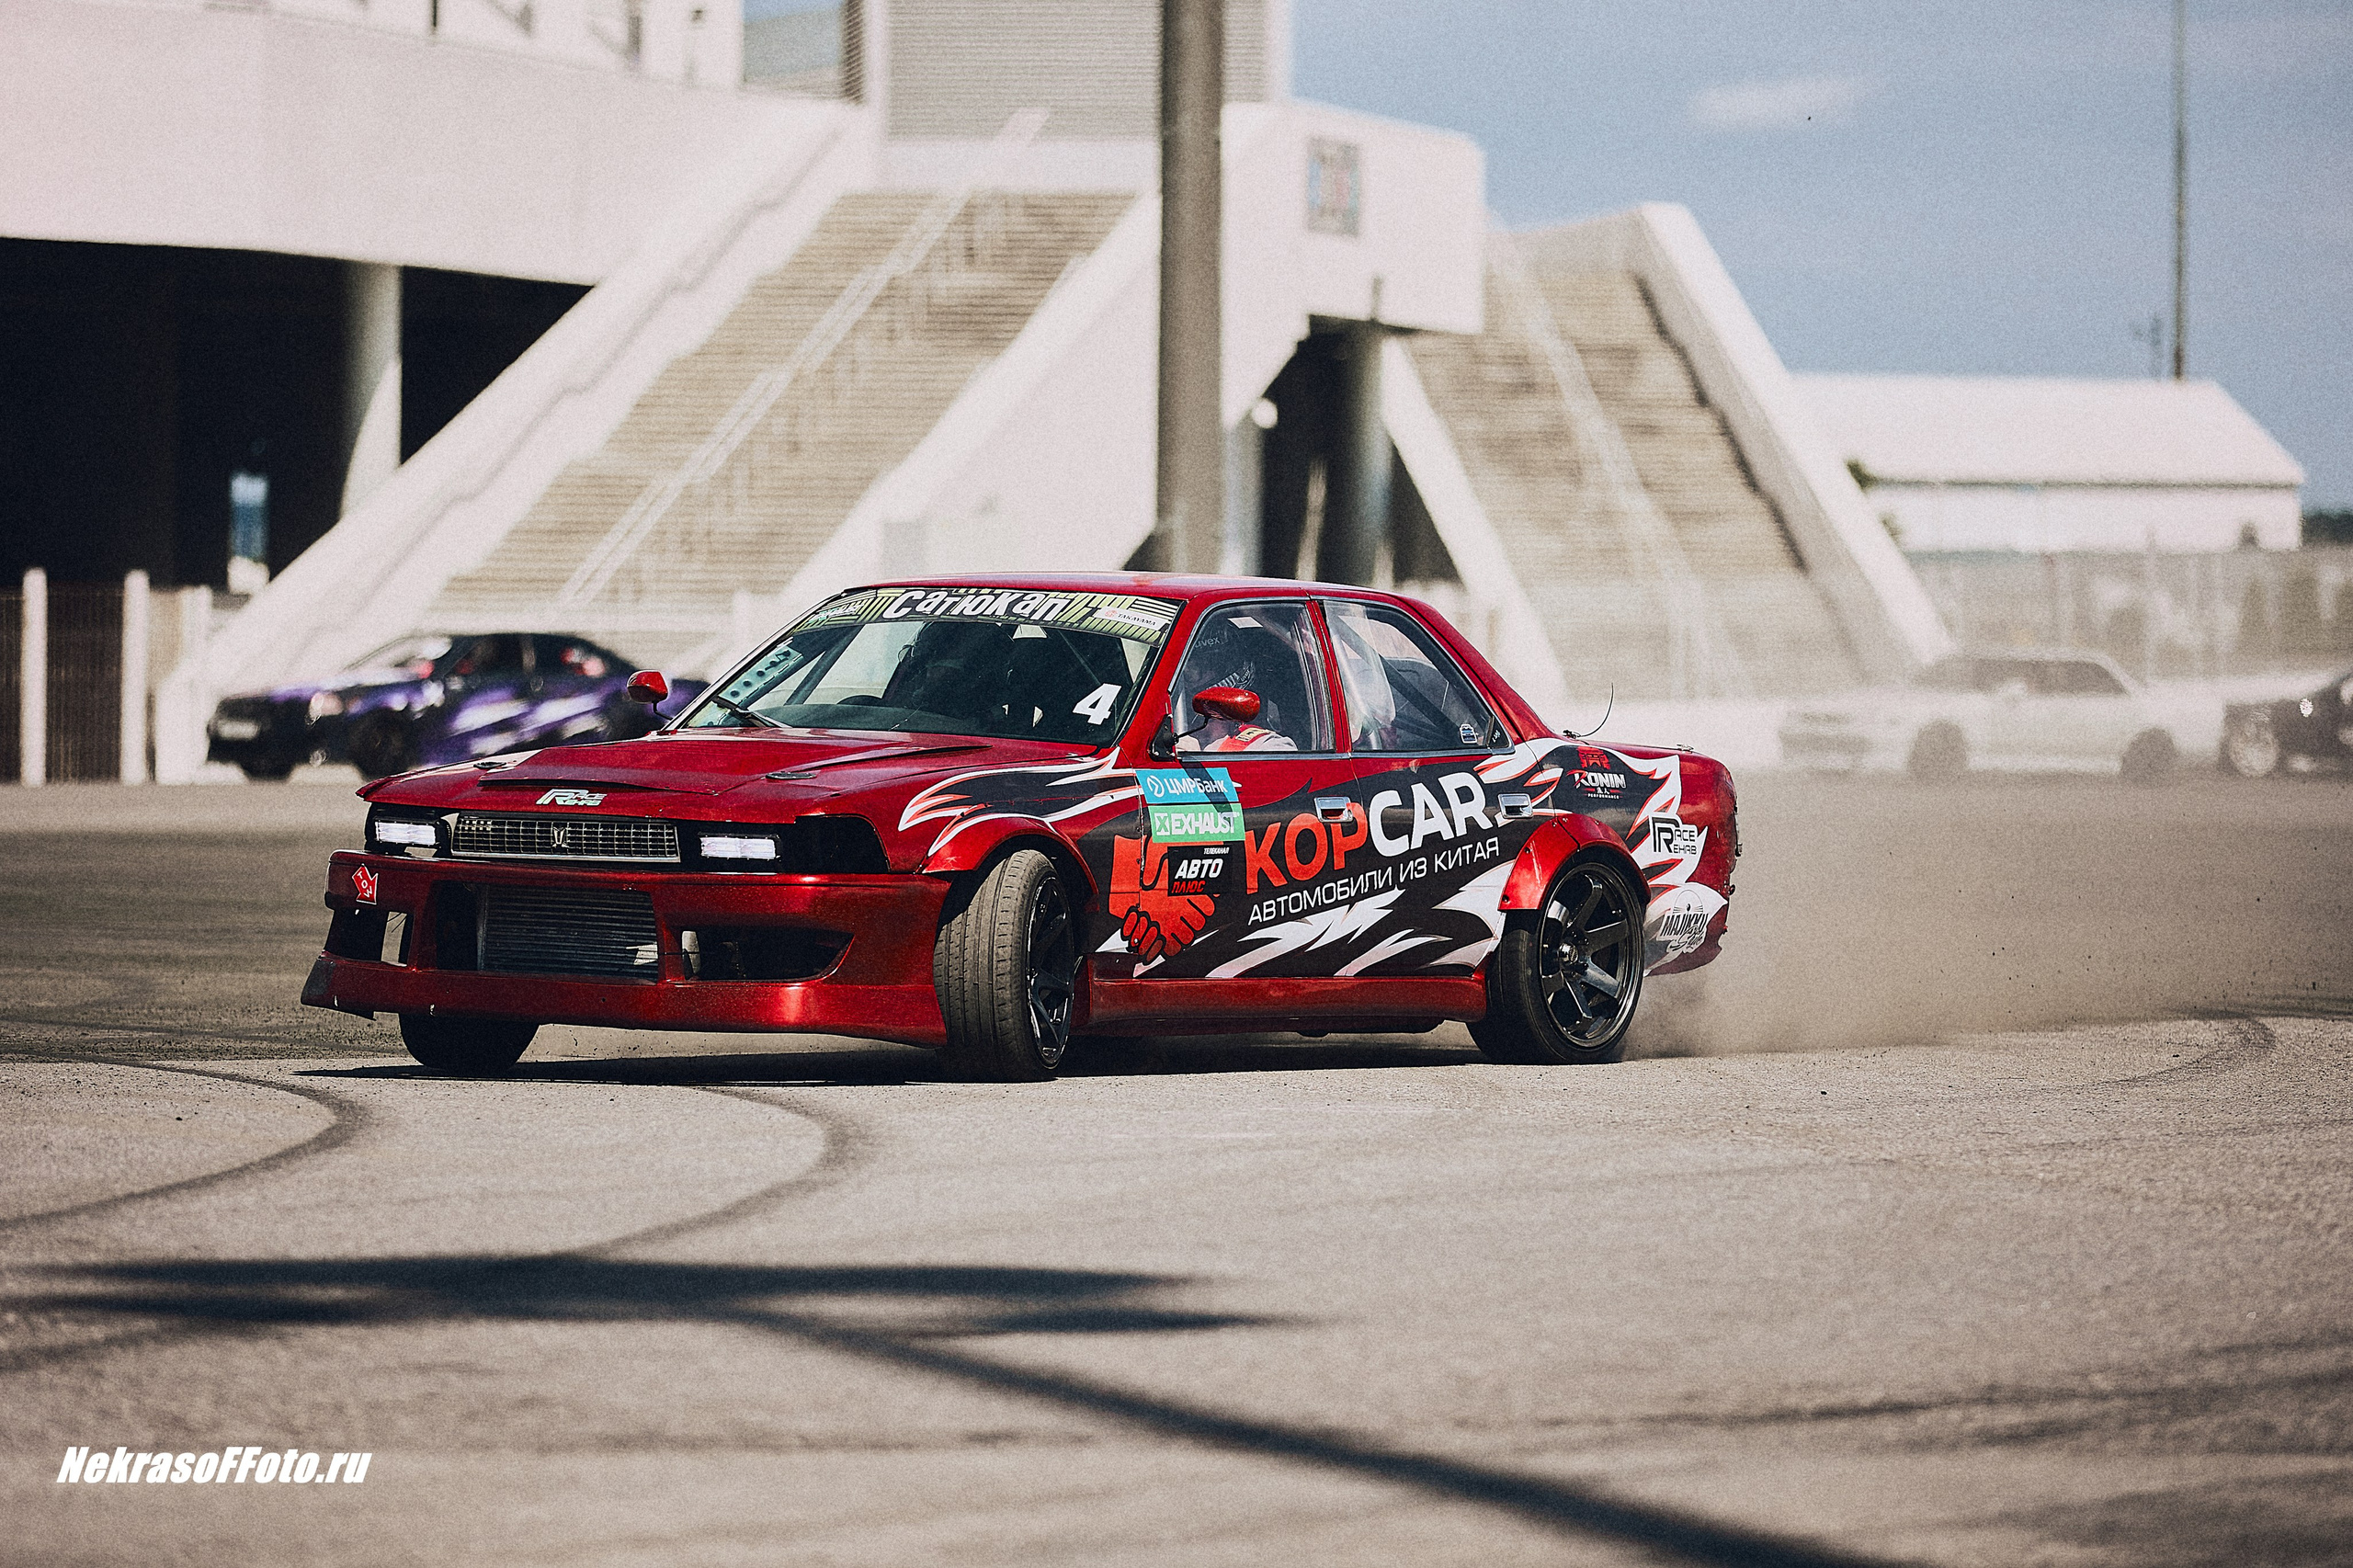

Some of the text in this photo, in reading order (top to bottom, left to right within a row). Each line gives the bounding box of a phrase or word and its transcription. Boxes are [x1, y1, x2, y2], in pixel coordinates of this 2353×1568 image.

[1118, 613, 1156, 626] TAKAYAMA
[1195, 637, 1221, 649] uvex
[1073, 683, 1121, 725] 4
[1164, 778, 1228, 795] ЦМРБанк
[1567, 769, 1627, 789] RONIN
[1171, 812, 1240, 835] EXHAUST
[1652, 817, 1696, 852] RACE
[1657, 827, 1697, 855] REHAB
[1203, 846, 1230, 855] ТЕЛЕКАНАЛ
[1174, 858, 1223, 879] АВТО
[357, 870, 372, 898] TOW
[1171, 881, 1206, 893] ПЛЮС
[1248, 836, 1499, 926] АВТОМОБИЛИ ИЗ КИТАЯ
